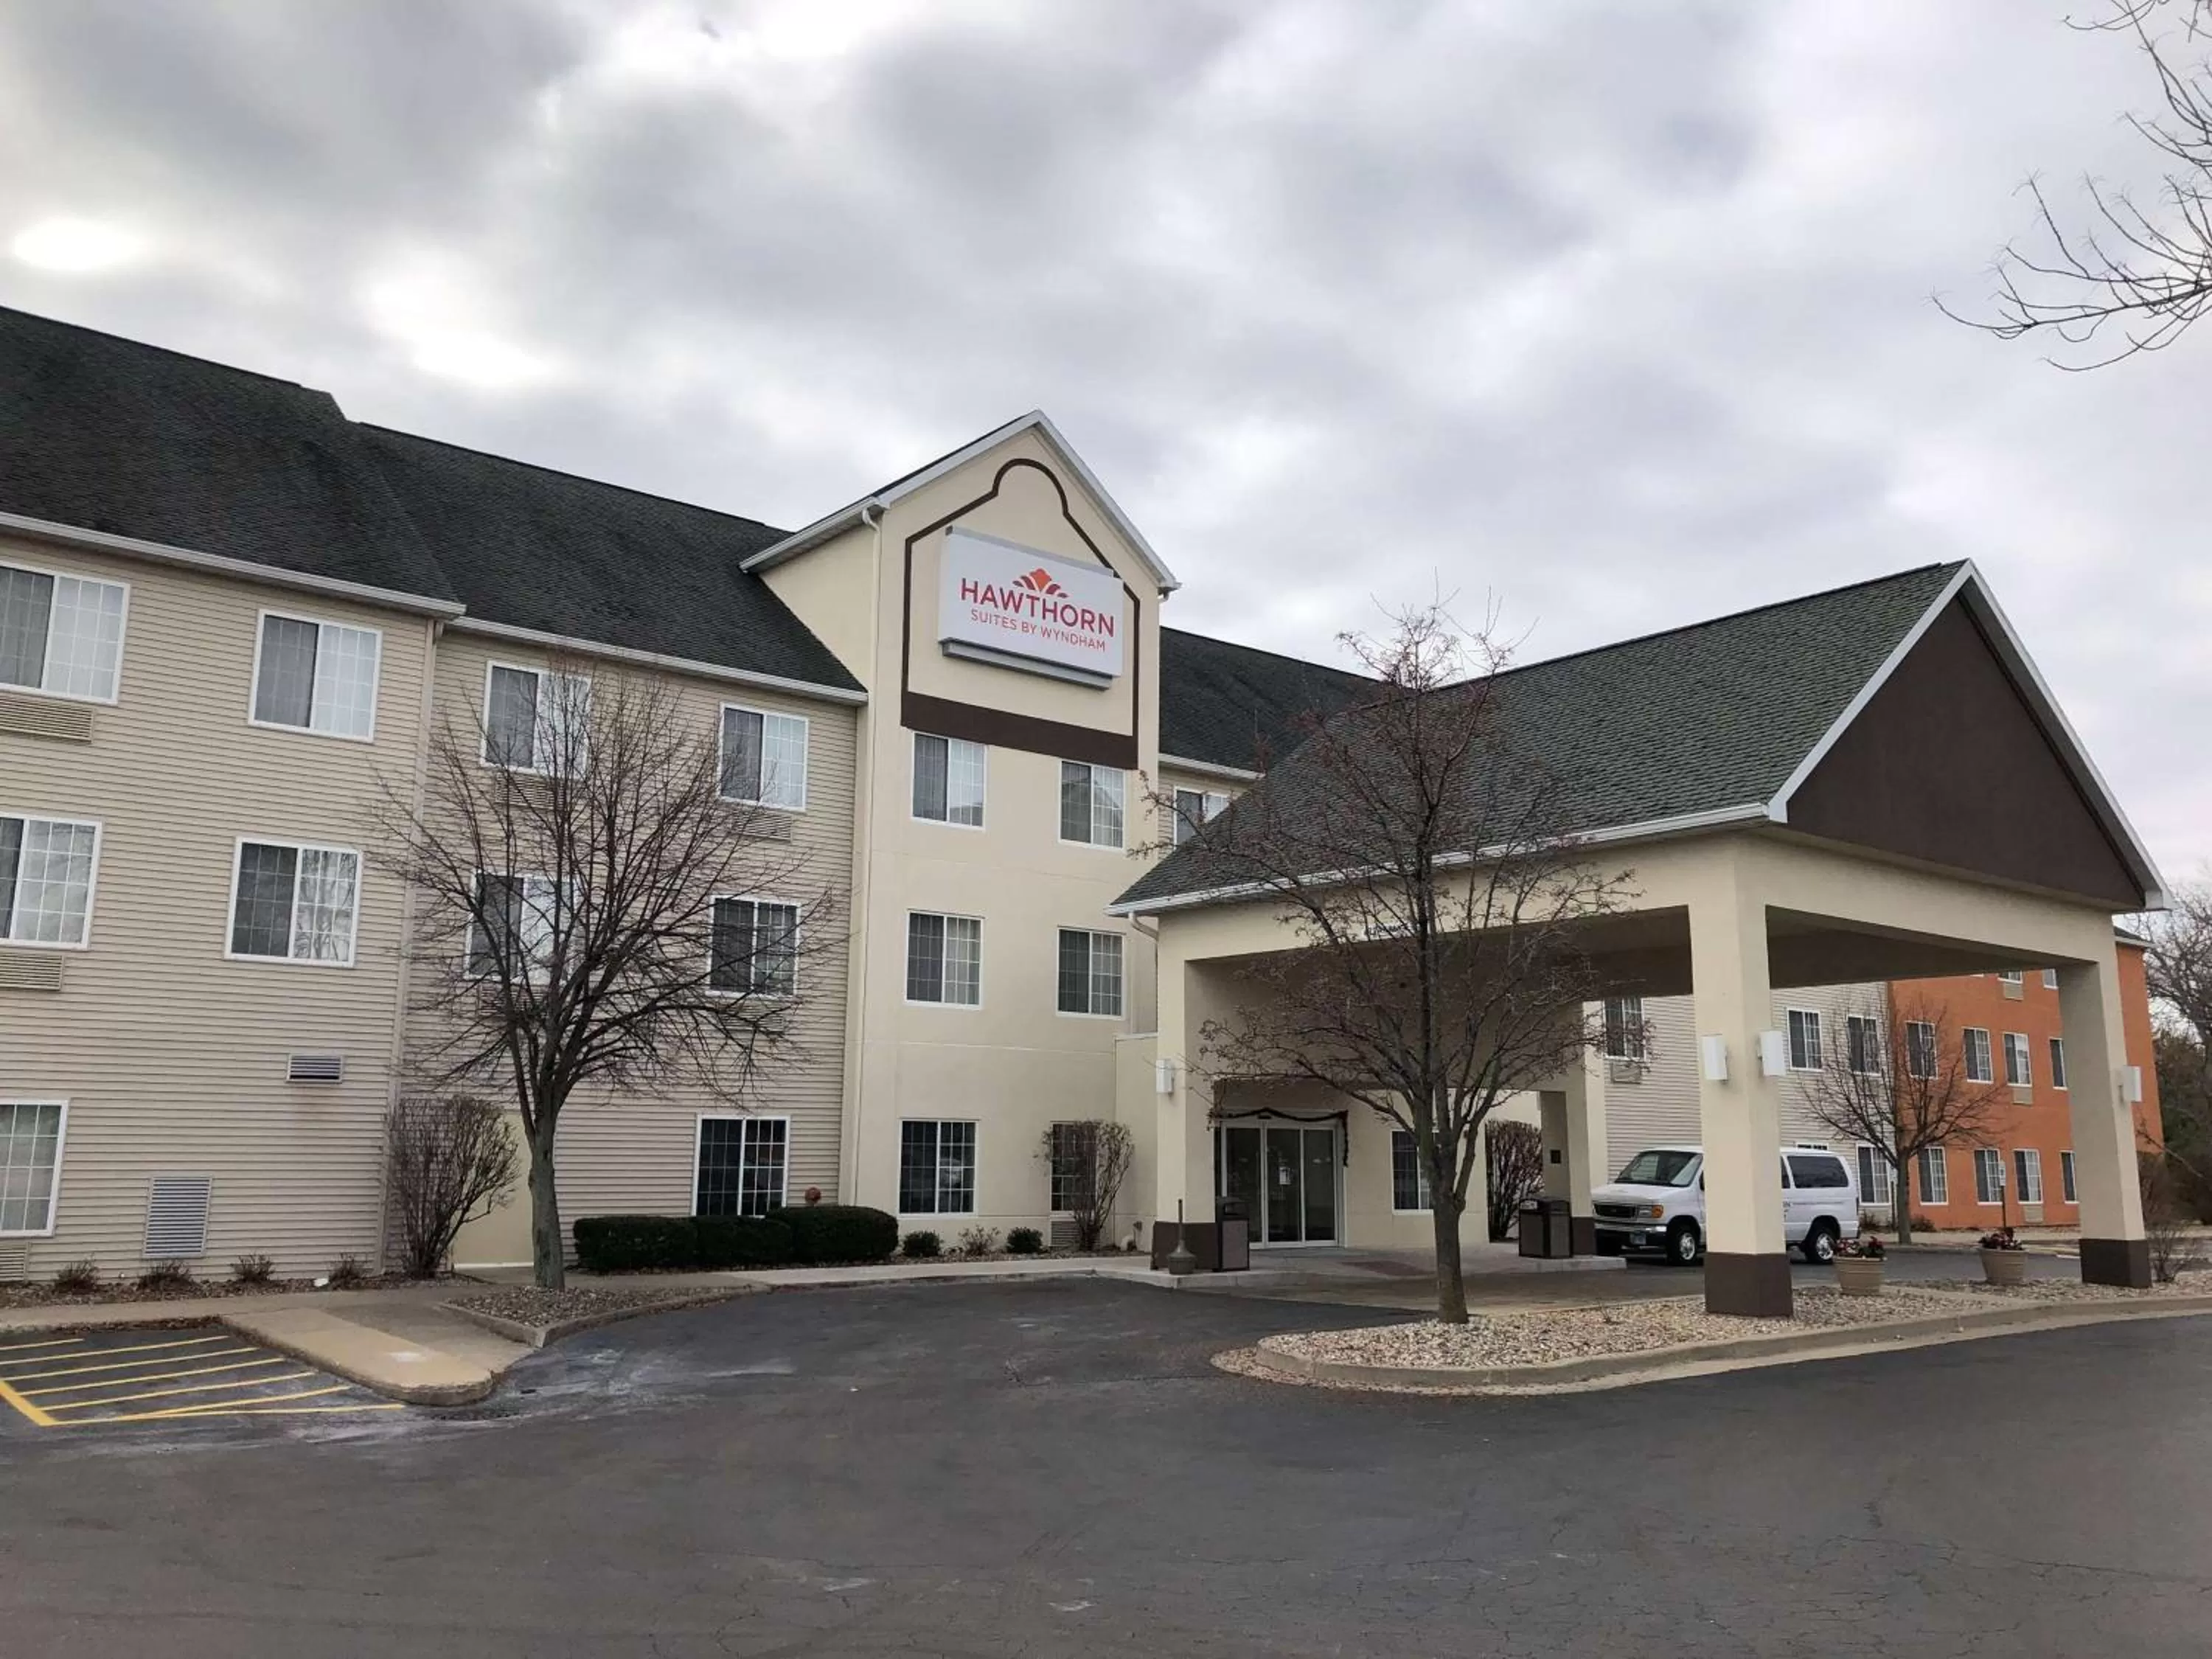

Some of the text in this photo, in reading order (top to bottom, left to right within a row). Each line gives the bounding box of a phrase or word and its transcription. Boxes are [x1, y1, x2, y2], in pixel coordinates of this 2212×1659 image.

[961, 578, 1114, 637] HAWTHORN
[970, 609, 1105, 652] SUITES BY WYNDHAM
